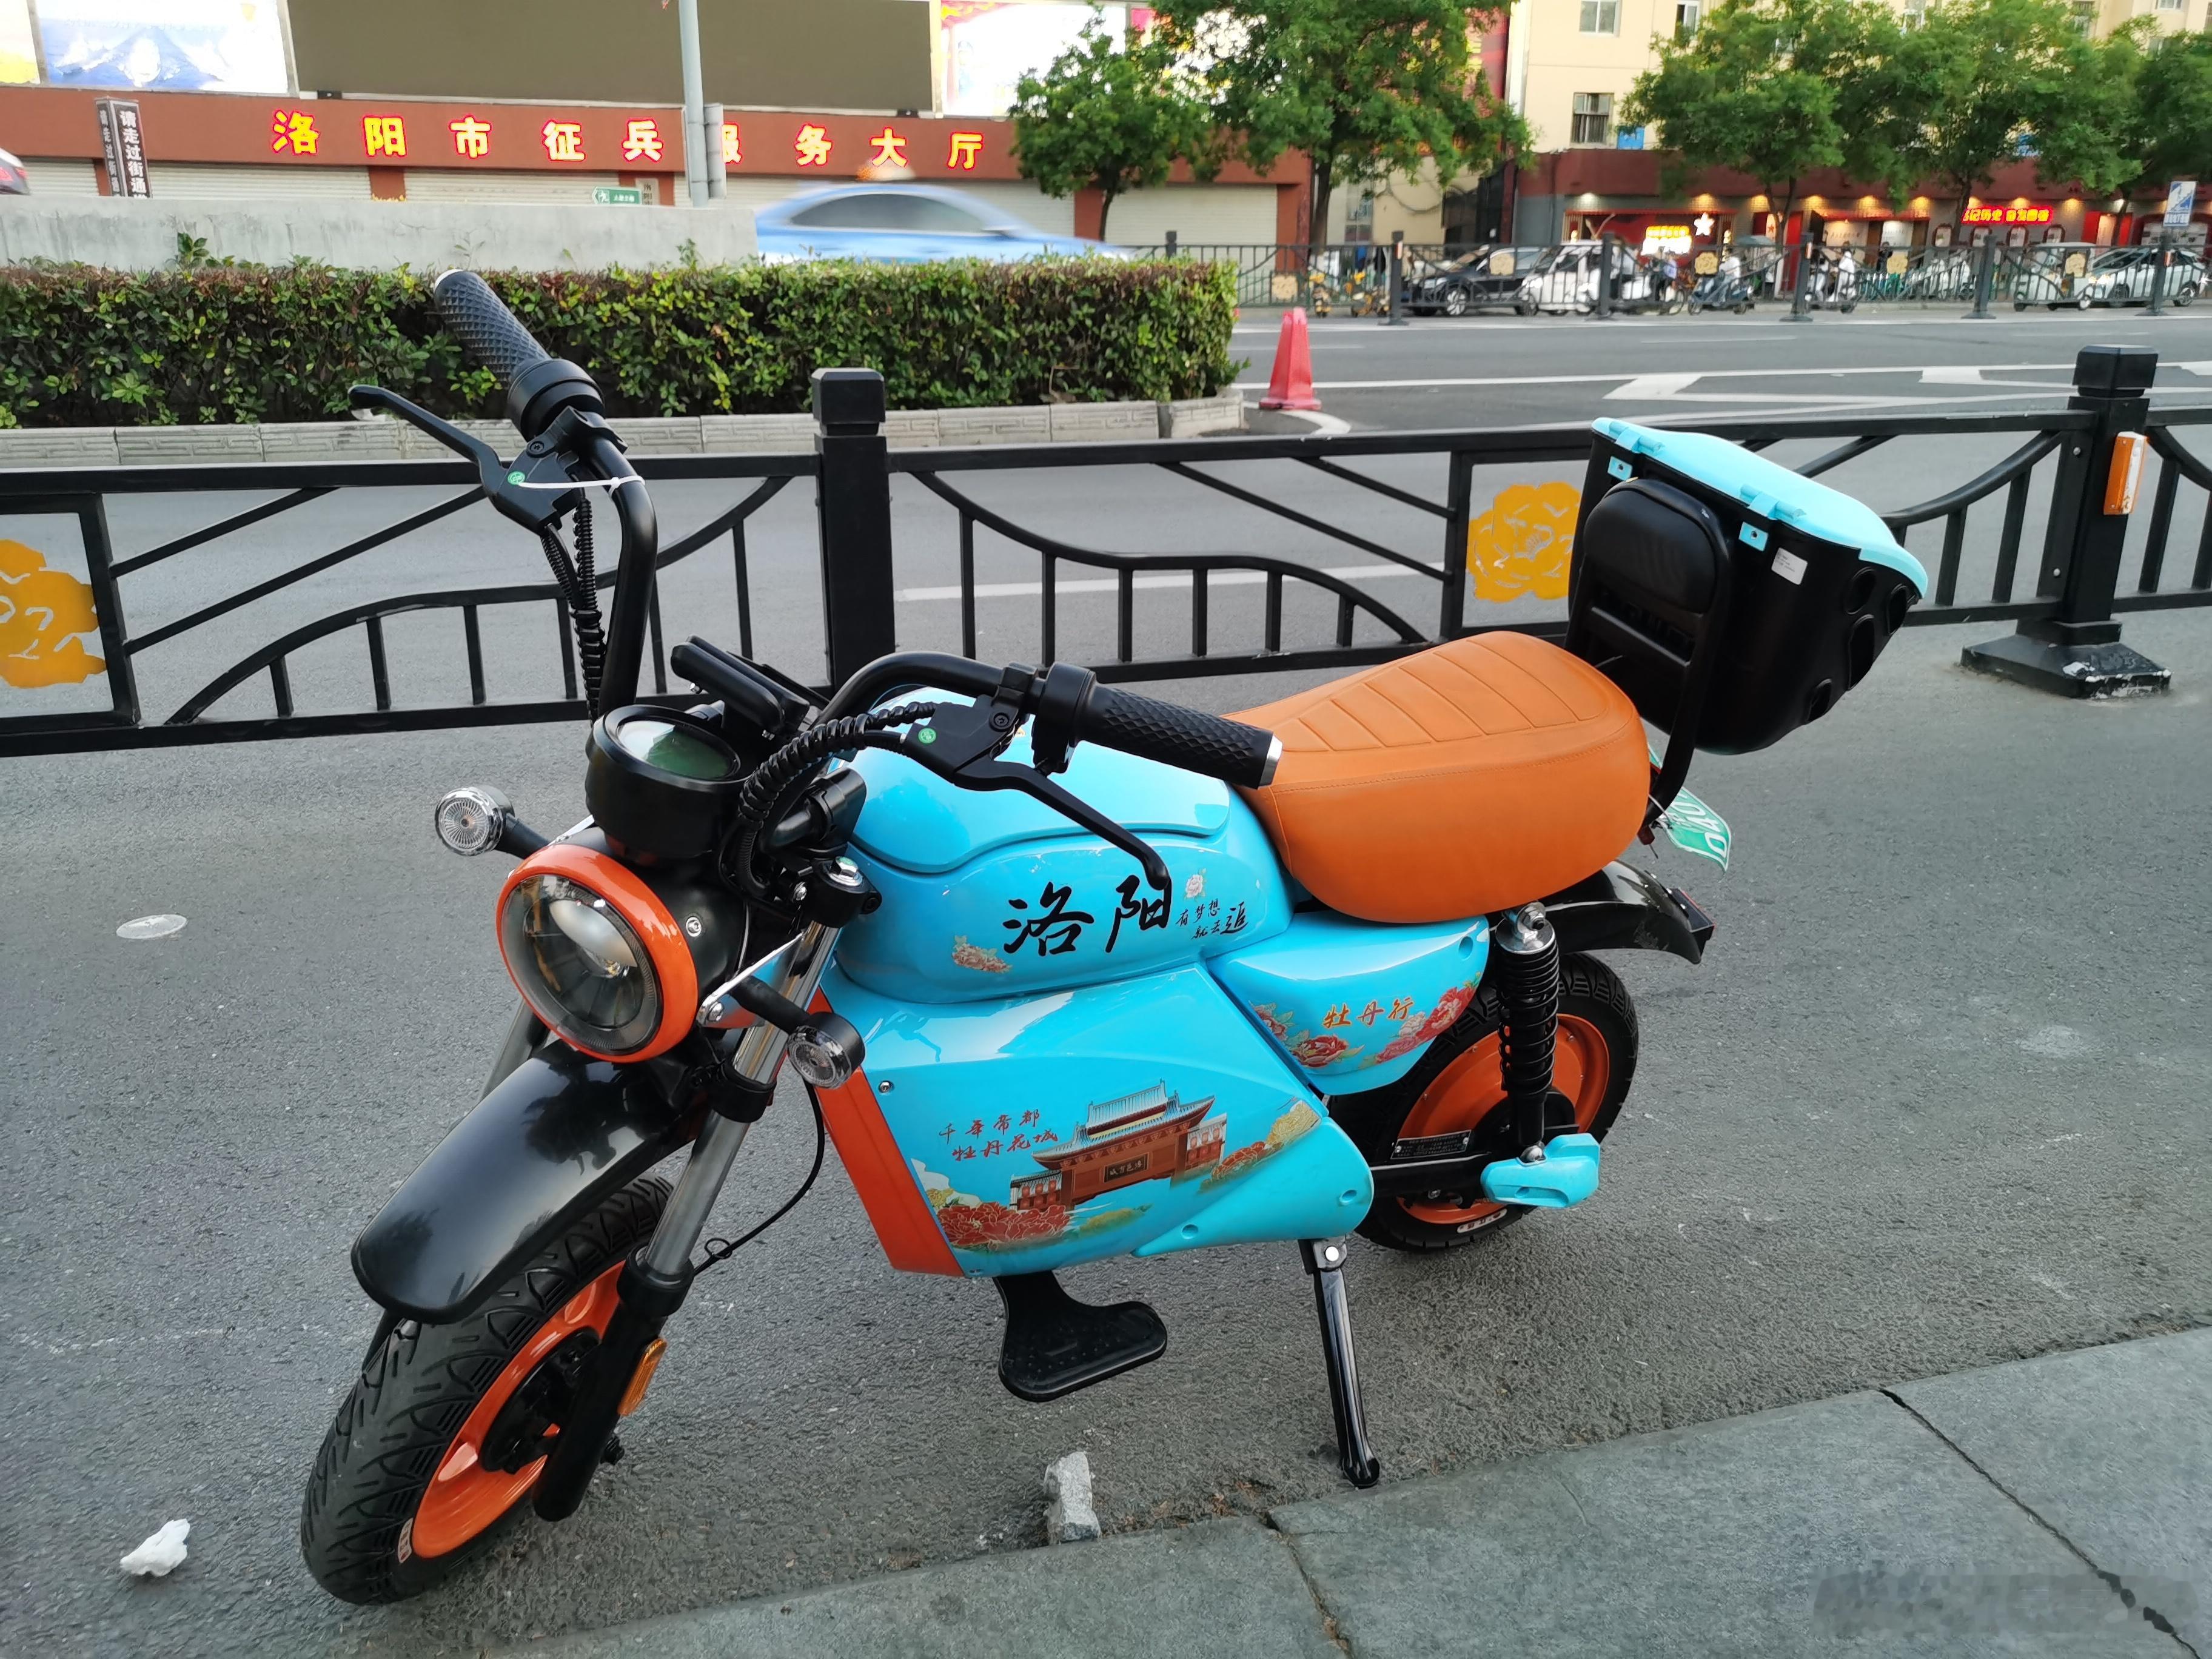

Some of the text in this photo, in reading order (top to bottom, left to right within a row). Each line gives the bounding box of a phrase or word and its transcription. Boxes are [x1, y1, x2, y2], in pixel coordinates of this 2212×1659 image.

[1003, 875, 1171, 956] 洛阳
[1322, 998, 1414, 1028] 牡丹行
[952, 1128, 1058, 1162] 牡丹花城
